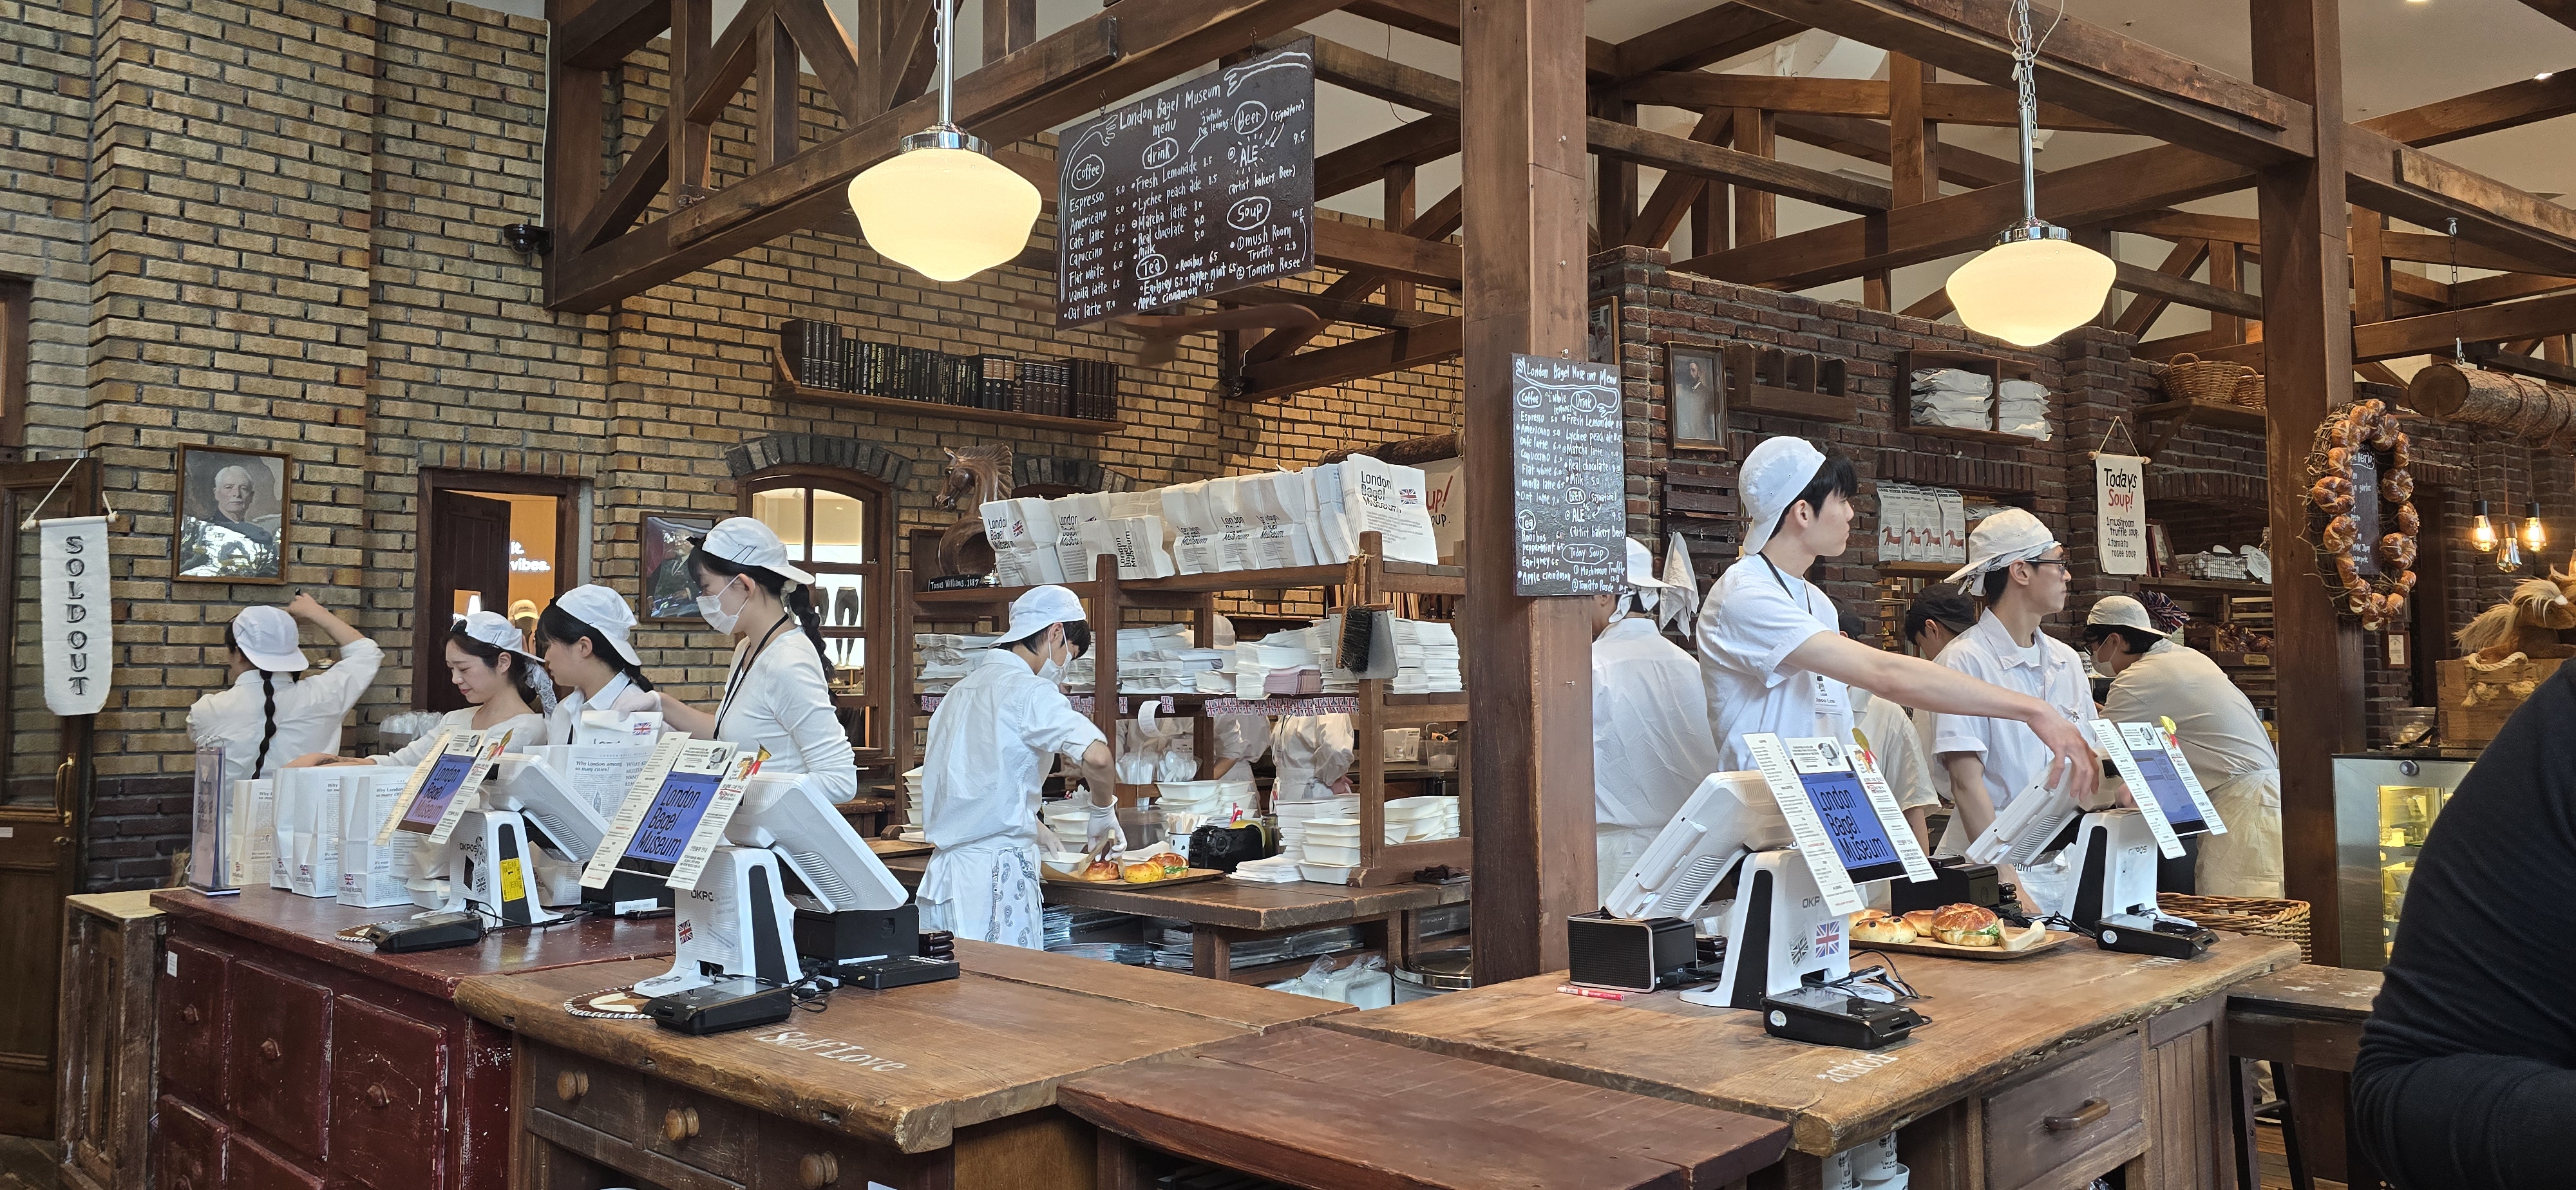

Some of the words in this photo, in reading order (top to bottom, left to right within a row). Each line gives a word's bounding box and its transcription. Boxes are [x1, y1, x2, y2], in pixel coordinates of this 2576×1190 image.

[1120, 102, 1153, 130] London
[1157, 93, 1179, 120] Bagel
[1185, 84, 1220, 109] Museum
[1152, 118, 1177, 138] menu
[1238, 109, 1262, 133] Beer
[1147, 140, 1171, 165] drink
[1240, 144, 1258, 167] ALE
[1136, 171, 1159, 193] Fresh
[1162, 155, 1197, 184] Lemonade
[1070, 191, 1104, 216] Espresso
[1138, 191, 1162, 215] Lychee
[1166, 182, 1186, 204] peach
[1189, 175, 1202, 193] ade
[1138, 209, 1164, 231] Matcha
[1170, 203, 1188, 220] latte
[1236, 203, 1264, 222] Soup
[1070, 209, 1107, 236] Americano
[1089, 229, 1104, 245] latte
[1138, 228, 1151, 247] Real
[1154, 221, 1184, 240] chocolate
[1272, 224, 1291, 241] Room
[1069, 247, 1103, 269] Capuccino
[1247, 244, 1273, 261] Truffle
[1141, 258, 1160, 277] Tea
[1180, 254, 1203, 272] Rooibos
[1246, 260, 1274, 278] Tomato
[1069, 270, 1083, 287] Flat
[1085, 263, 1104, 279] white
[1092, 281, 1108, 297] latte
[1068, 306, 1081, 320] Oat
[1084, 301, 1102, 318] latte
[1137, 294, 1157, 311] Apple
[1527, 363, 1548, 379] London
[1553, 362, 1569, 381] Bagel
[1599, 368, 1618, 386] Menu
[1575, 393, 1592, 409] Drink
[1520, 410, 1545, 426] Espresso
[1566, 413, 1584, 427] Fresh
[1586, 414, 1615, 430] Lemonade
[1520, 423, 1550, 437] Americano
[1566, 428, 1587, 444] Lychee
[1533, 435, 1549, 450] latte
[1566, 443, 1587, 456] Matcha
[1521, 463, 1535, 476] Flat
[1568, 457, 1581, 471] Real
[1361, 470, 1392, 490] London
[1361, 483, 1386, 500] Bagel
[2108, 488, 2134, 513] Soup!
[1519, 515, 1533, 529] Tea
[1571, 507, 1586, 524] ALE
[1568, 546, 1586, 562] Today
[1589, 546, 1604, 560] Soup
[509, 558, 551, 571] vibes.
[1522, 571, 1540, 585] Apple
[433, 764, 461, 783] London
[422, 781, 448, 804] Bagel
[660, 784, 701, 809] London
[1812, 785, 1857, 811] London
[647, 807, 683, 835] Bagel
[1824, 809, 1861, 840] Bagel
[634, 829, 682, 858] Museum
[1837, 837, 1889, 863] Museum
